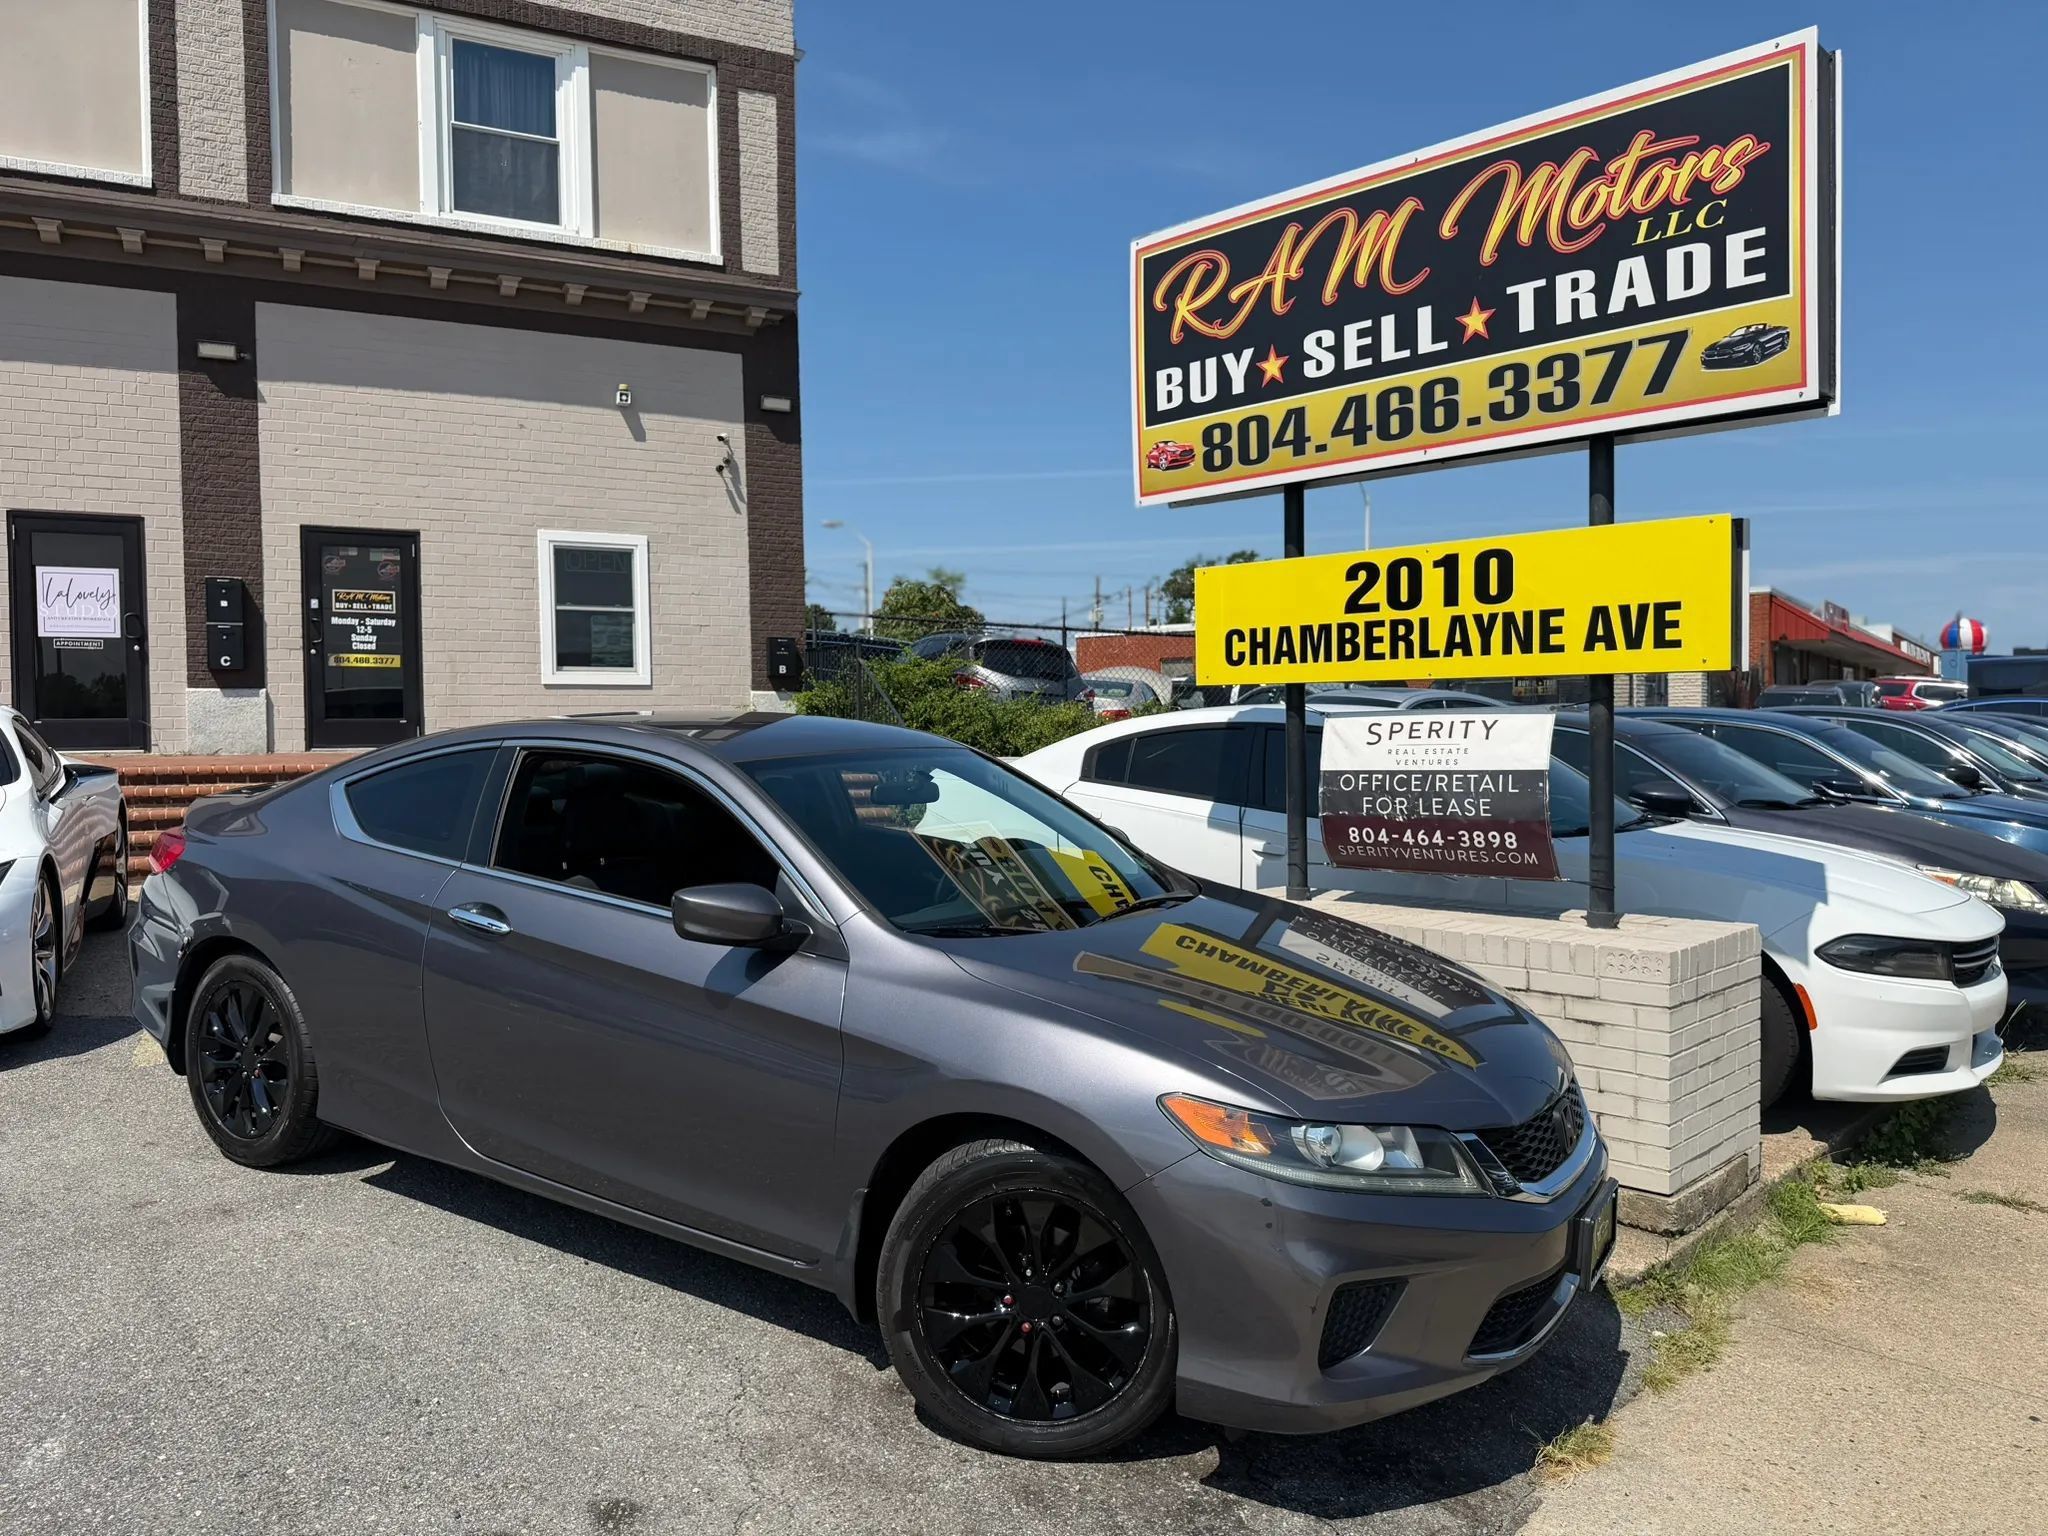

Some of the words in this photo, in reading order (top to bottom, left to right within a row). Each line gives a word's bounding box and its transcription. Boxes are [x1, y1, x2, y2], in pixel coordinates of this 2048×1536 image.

[1439, 130, 1771, 267] Motors
[1633, 199, 1729, 247] LLC
[1155, 346, 1254, 413] BUY
[1303, 303, 1449, 380] SELL
[1506, 226, 1767, 335] TRADE
[1201, 327, 1693, 475] 804.466.3377
[1343, 547, 1515, 615] 2010
[372, 603, 393, 611] TRADE
[331, 616, 360, 626] Monday
[365, 617, 396, 627] Saturday
[356, 626, 373, 634] 12-5
[351, 633, 377, 643] Sunday
[1224, 608, 1566, 668] CHAMBERLAYNE
[1583, 600, 1683, 653] AVE
[352, 642, 376, 650] Closed
[220, 655, 231, 667] C
[779, 665, 787, 674] B
[1366, 719, 1500, 747] SPERITY
[1387, 748, 1419, 756] REAL
[1424, 747, 1469, 755] ESTATE
[1395, 758, 1459, 767] VENTURES
[1340, 773, 1520, 794] OFFICE/RETAIL
[1362, 797, 1410, 816] FOR
[1418, 796, 1493, 817] LEASE
[1348, 827, 1519, 849] 804-464-3898
[1338, 844, 1539, 866] SPERITYVENTURES.COM
